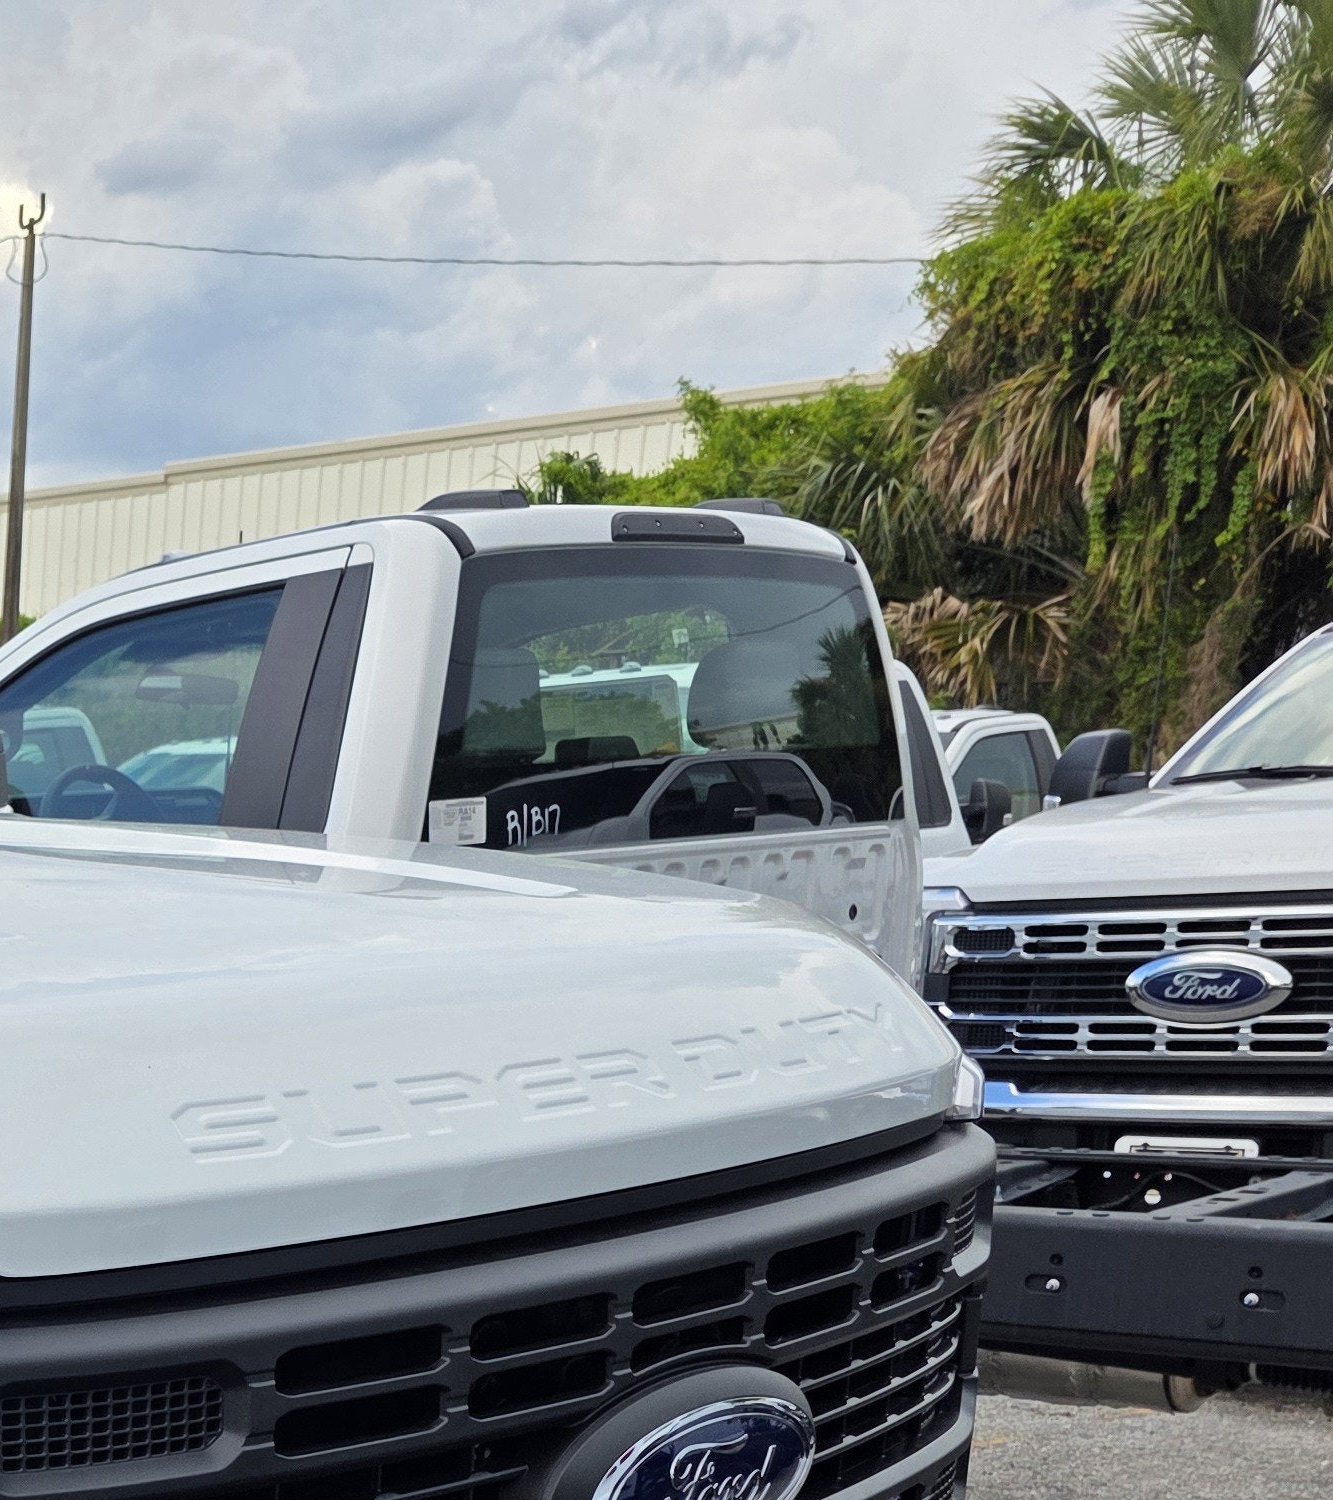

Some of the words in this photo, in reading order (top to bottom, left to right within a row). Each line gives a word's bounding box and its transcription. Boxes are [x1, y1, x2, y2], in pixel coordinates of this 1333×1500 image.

[1164, 971, 1241, 1000] Ford
[170, 1046, 676, 1164] SUPER
[671, 1000, 907, 1091] DUTY
